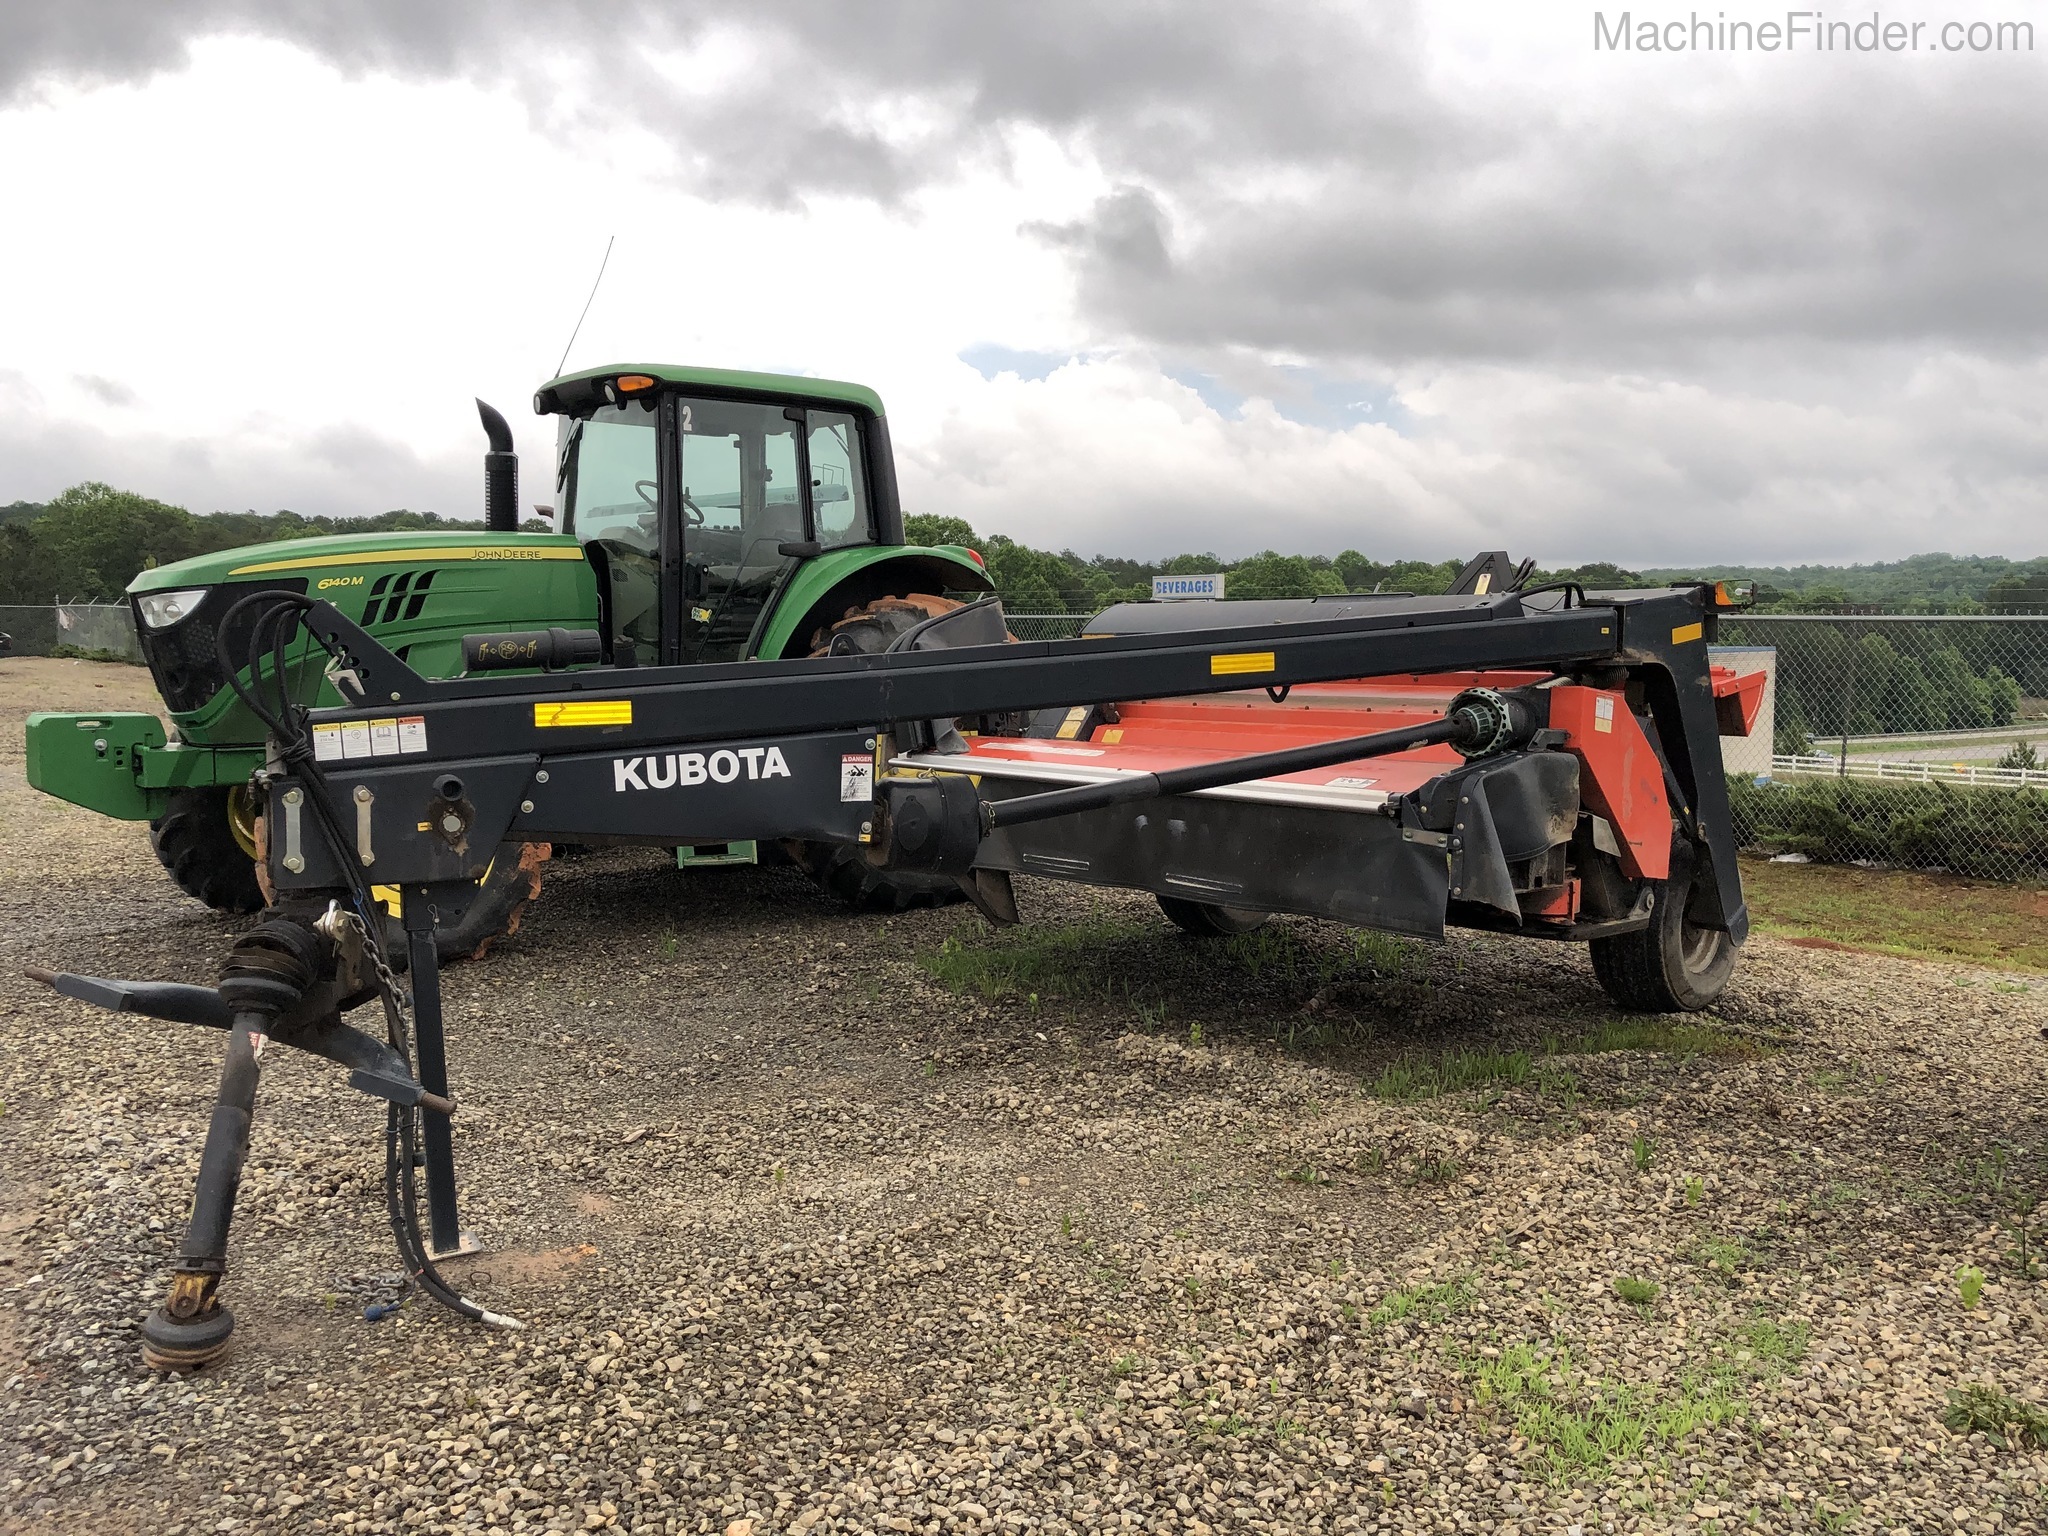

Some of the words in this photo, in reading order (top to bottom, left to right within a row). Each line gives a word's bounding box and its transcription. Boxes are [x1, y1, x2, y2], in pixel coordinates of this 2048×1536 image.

[682, 405, 693, 432] 2
[471, 549, 502, 559] JOHN
[503, 549, 541, 559] DEERE
[613, 746, 792, 792] KUBOTA
